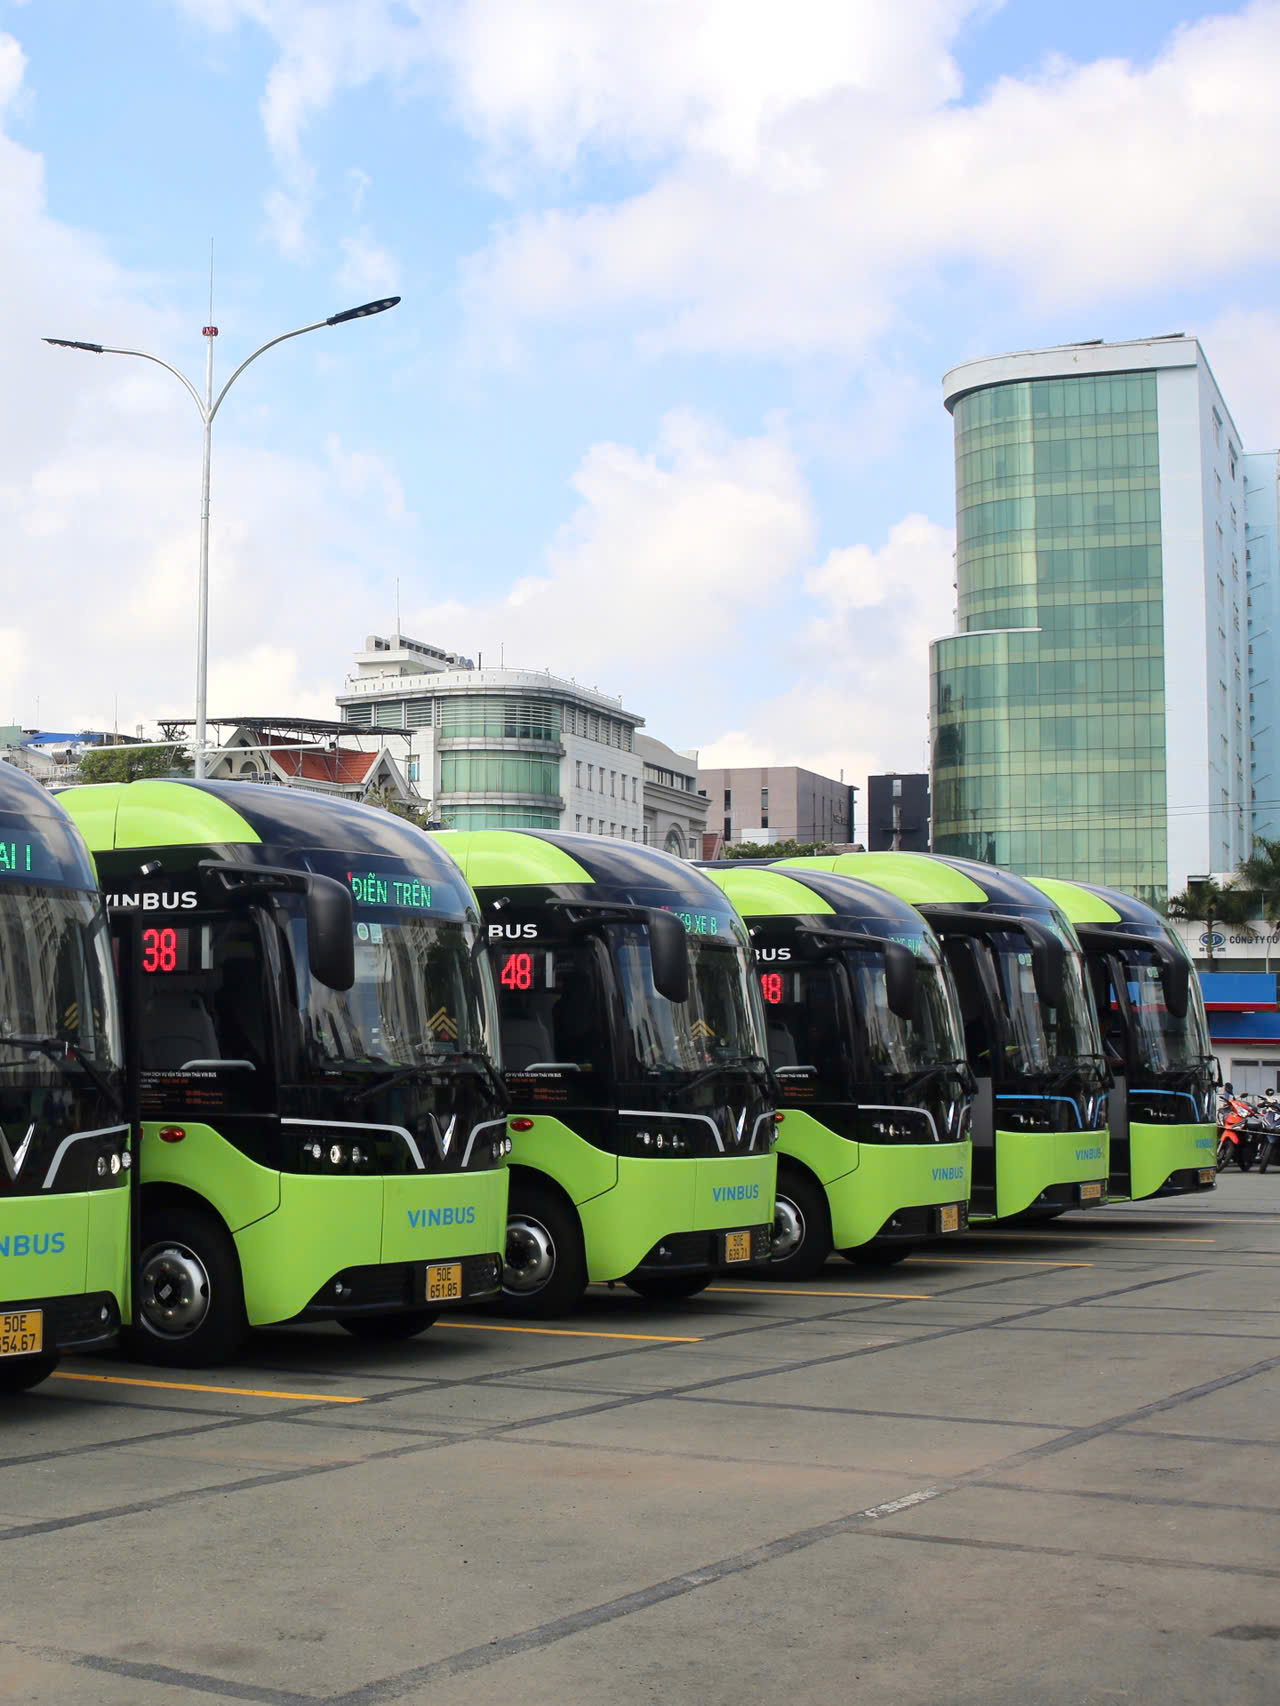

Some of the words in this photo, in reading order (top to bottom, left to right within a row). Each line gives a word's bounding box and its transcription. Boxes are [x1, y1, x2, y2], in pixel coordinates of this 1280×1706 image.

[392, 879, 431, 907] TRÊN
[142, 928, 177, 972] 38
[501, 953, 531, 990] 48
[931, 1167, 964, 1181] VINBUS
[712, 1184, 759, 1202] VINBUS
[407, 1205, 475, 1228] VINBUS
[436, 1266, 452, 1282] 50E
[430, 1282, 458, 1299] 651.85
[4, 1314, 27, 1333] 50E
